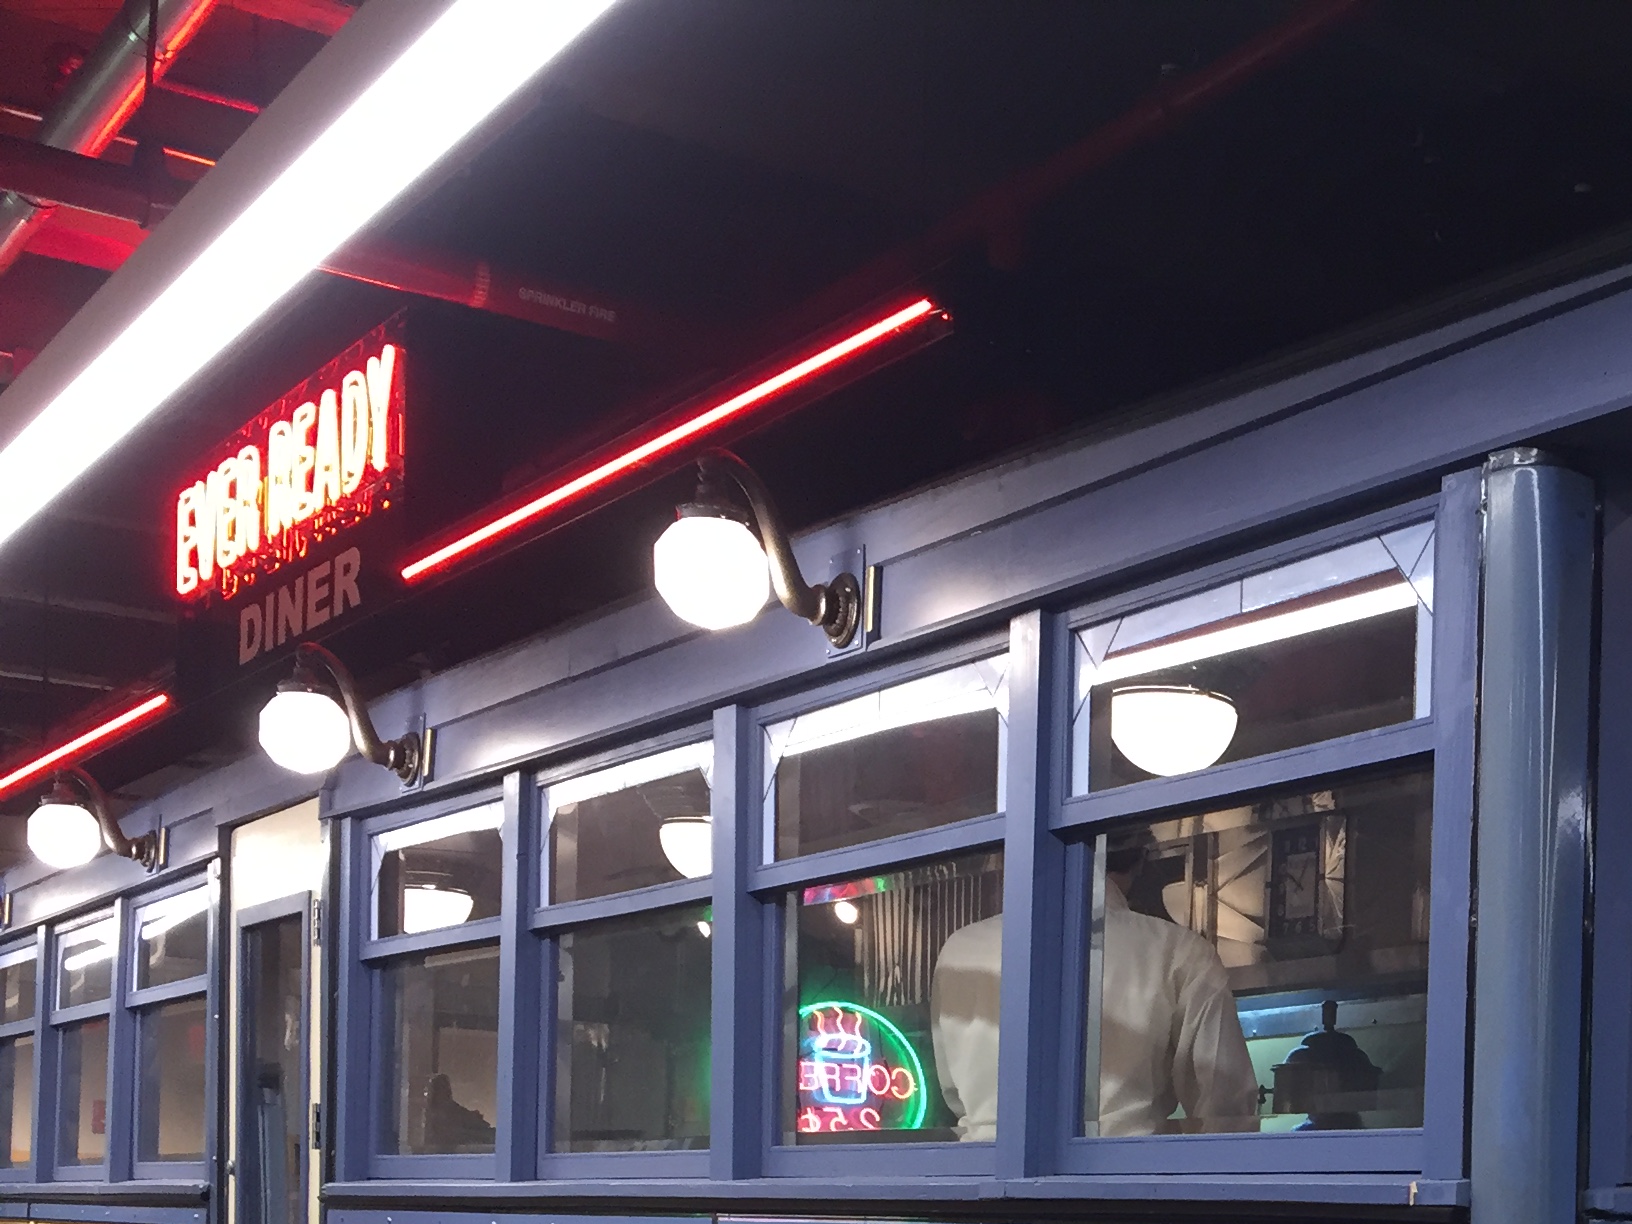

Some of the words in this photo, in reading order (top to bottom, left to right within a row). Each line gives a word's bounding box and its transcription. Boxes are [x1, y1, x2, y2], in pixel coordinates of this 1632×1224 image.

[518, 287, 586, 314] SPRINKLER
[588, 305, 617, 323] FIRE
[177, 445, 260, 595] EVER
[267, 344, 395, 535] READY
[239, 547, 362, 666] DINER
